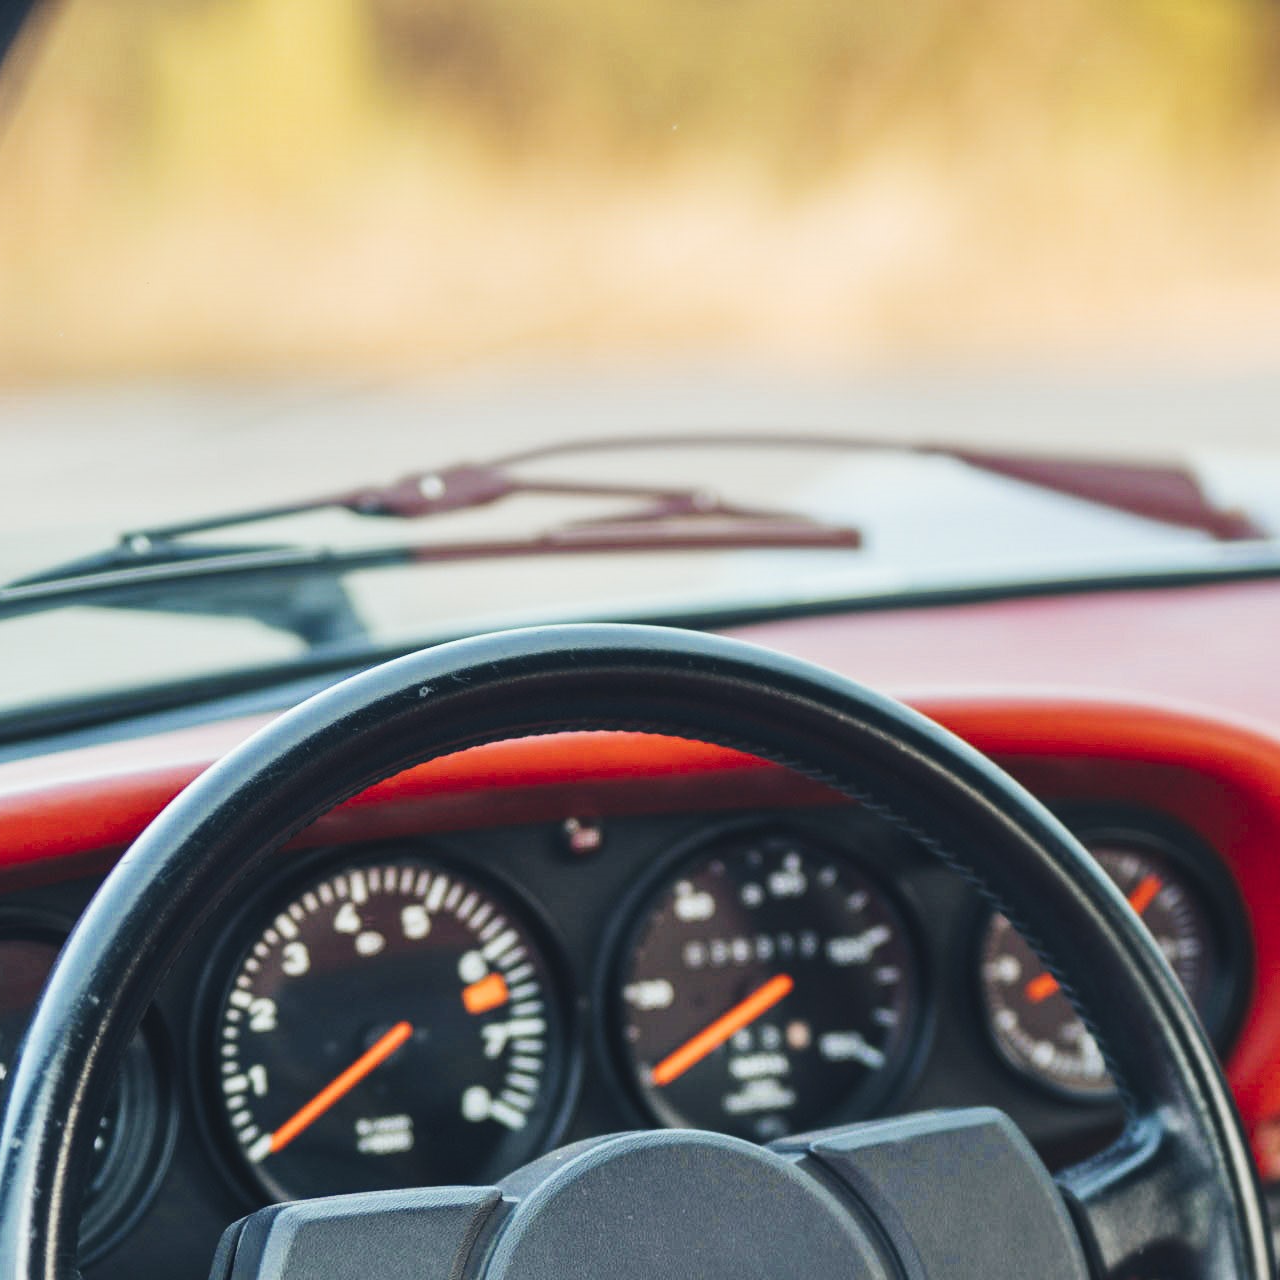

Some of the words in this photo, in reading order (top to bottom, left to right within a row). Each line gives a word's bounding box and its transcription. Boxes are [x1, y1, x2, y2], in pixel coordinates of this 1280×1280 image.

[283, 942, 310, 975] 3
[249, 998, 276, 1032] 2
[249, 1065, 266, 1096] 1
